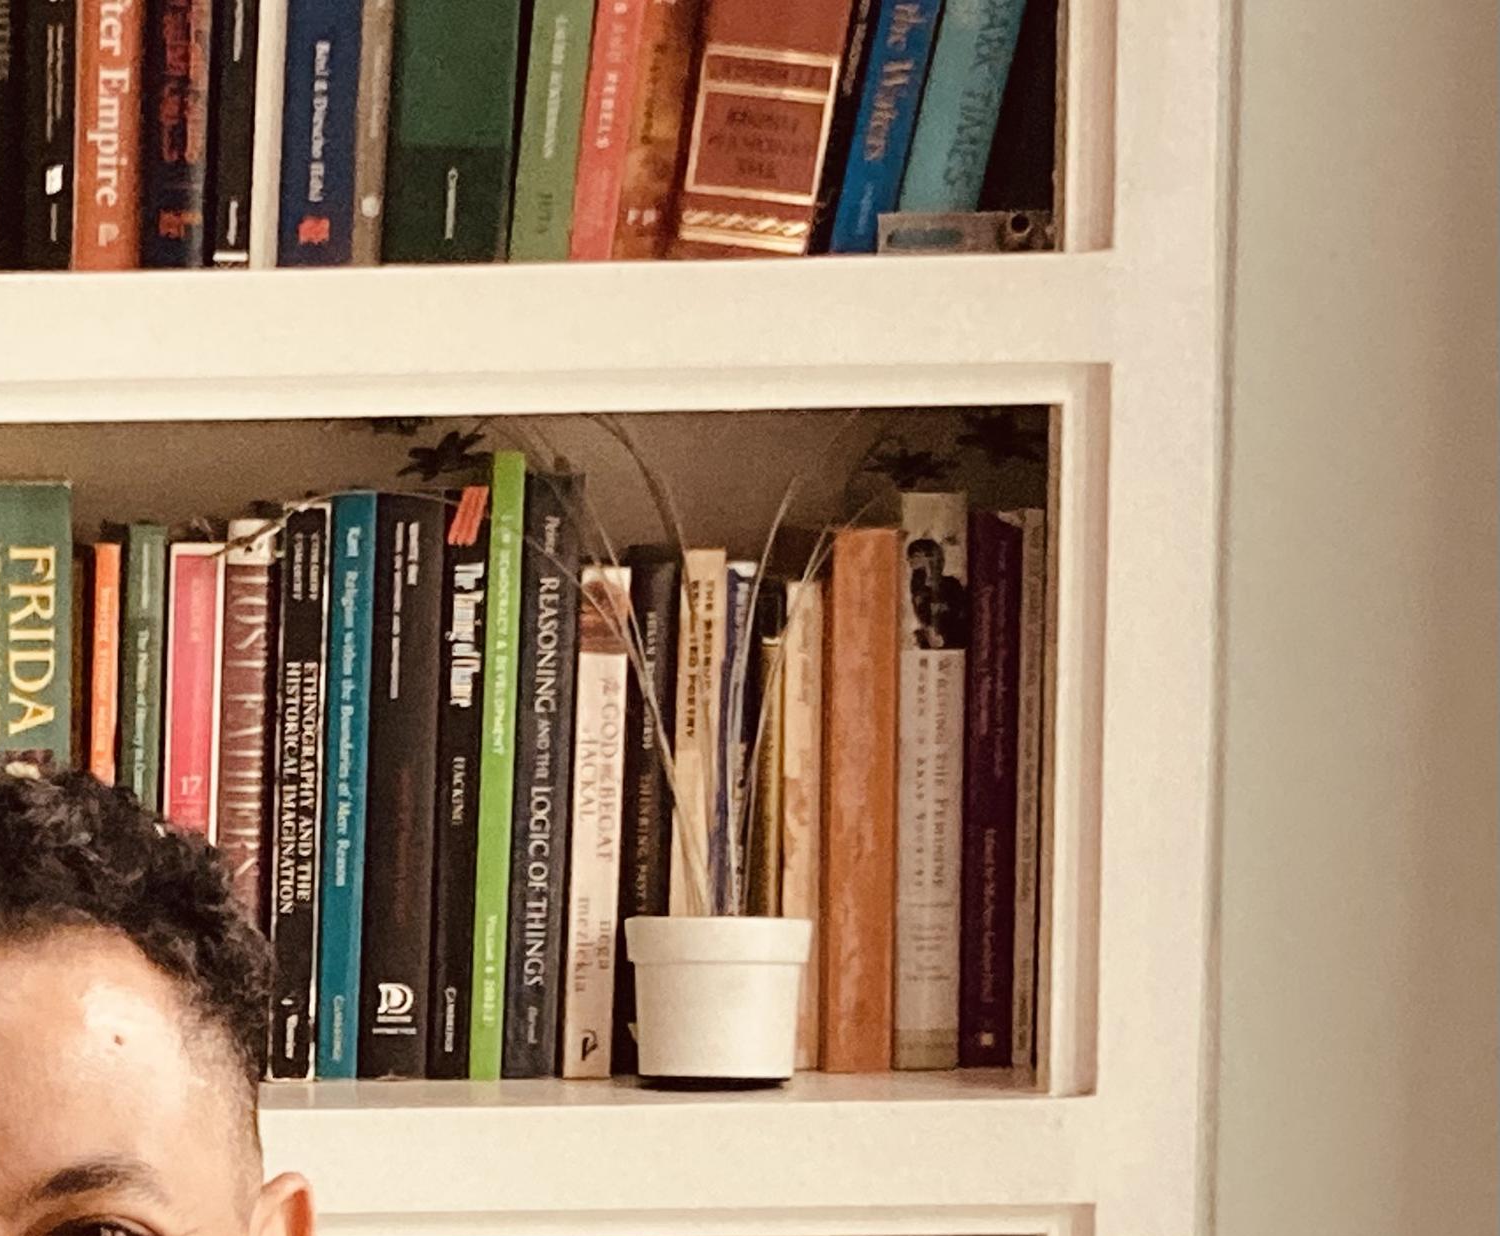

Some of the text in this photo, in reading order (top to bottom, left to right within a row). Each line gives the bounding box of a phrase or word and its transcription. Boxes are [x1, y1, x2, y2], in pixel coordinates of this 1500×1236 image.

[87, 66, 130, 207] Empire
[345, 526, 361, 558] Kant
[454, 562, 485, 590] The
[6, 545, 56, 737] FRIDA
[179, 775, 202, 796] 17
[279, 662, 302, 914] HISTORICAL IMAGINATION
[296, 662, 319, 902] ETHNOGRAPHY AND THE
[334, 570, 359, 887] Religion within the Boundaries of Mere Reason
[523, 576, 561, 987] REASONING AND THE LOGIC OF THINGS
[579, 738, 598, 821] JACKAL
[596, 702, 619, 863] GOD BEGAT
[574, 897, 592, 993] mezlekia
[596, 920, 612, 971] nega
